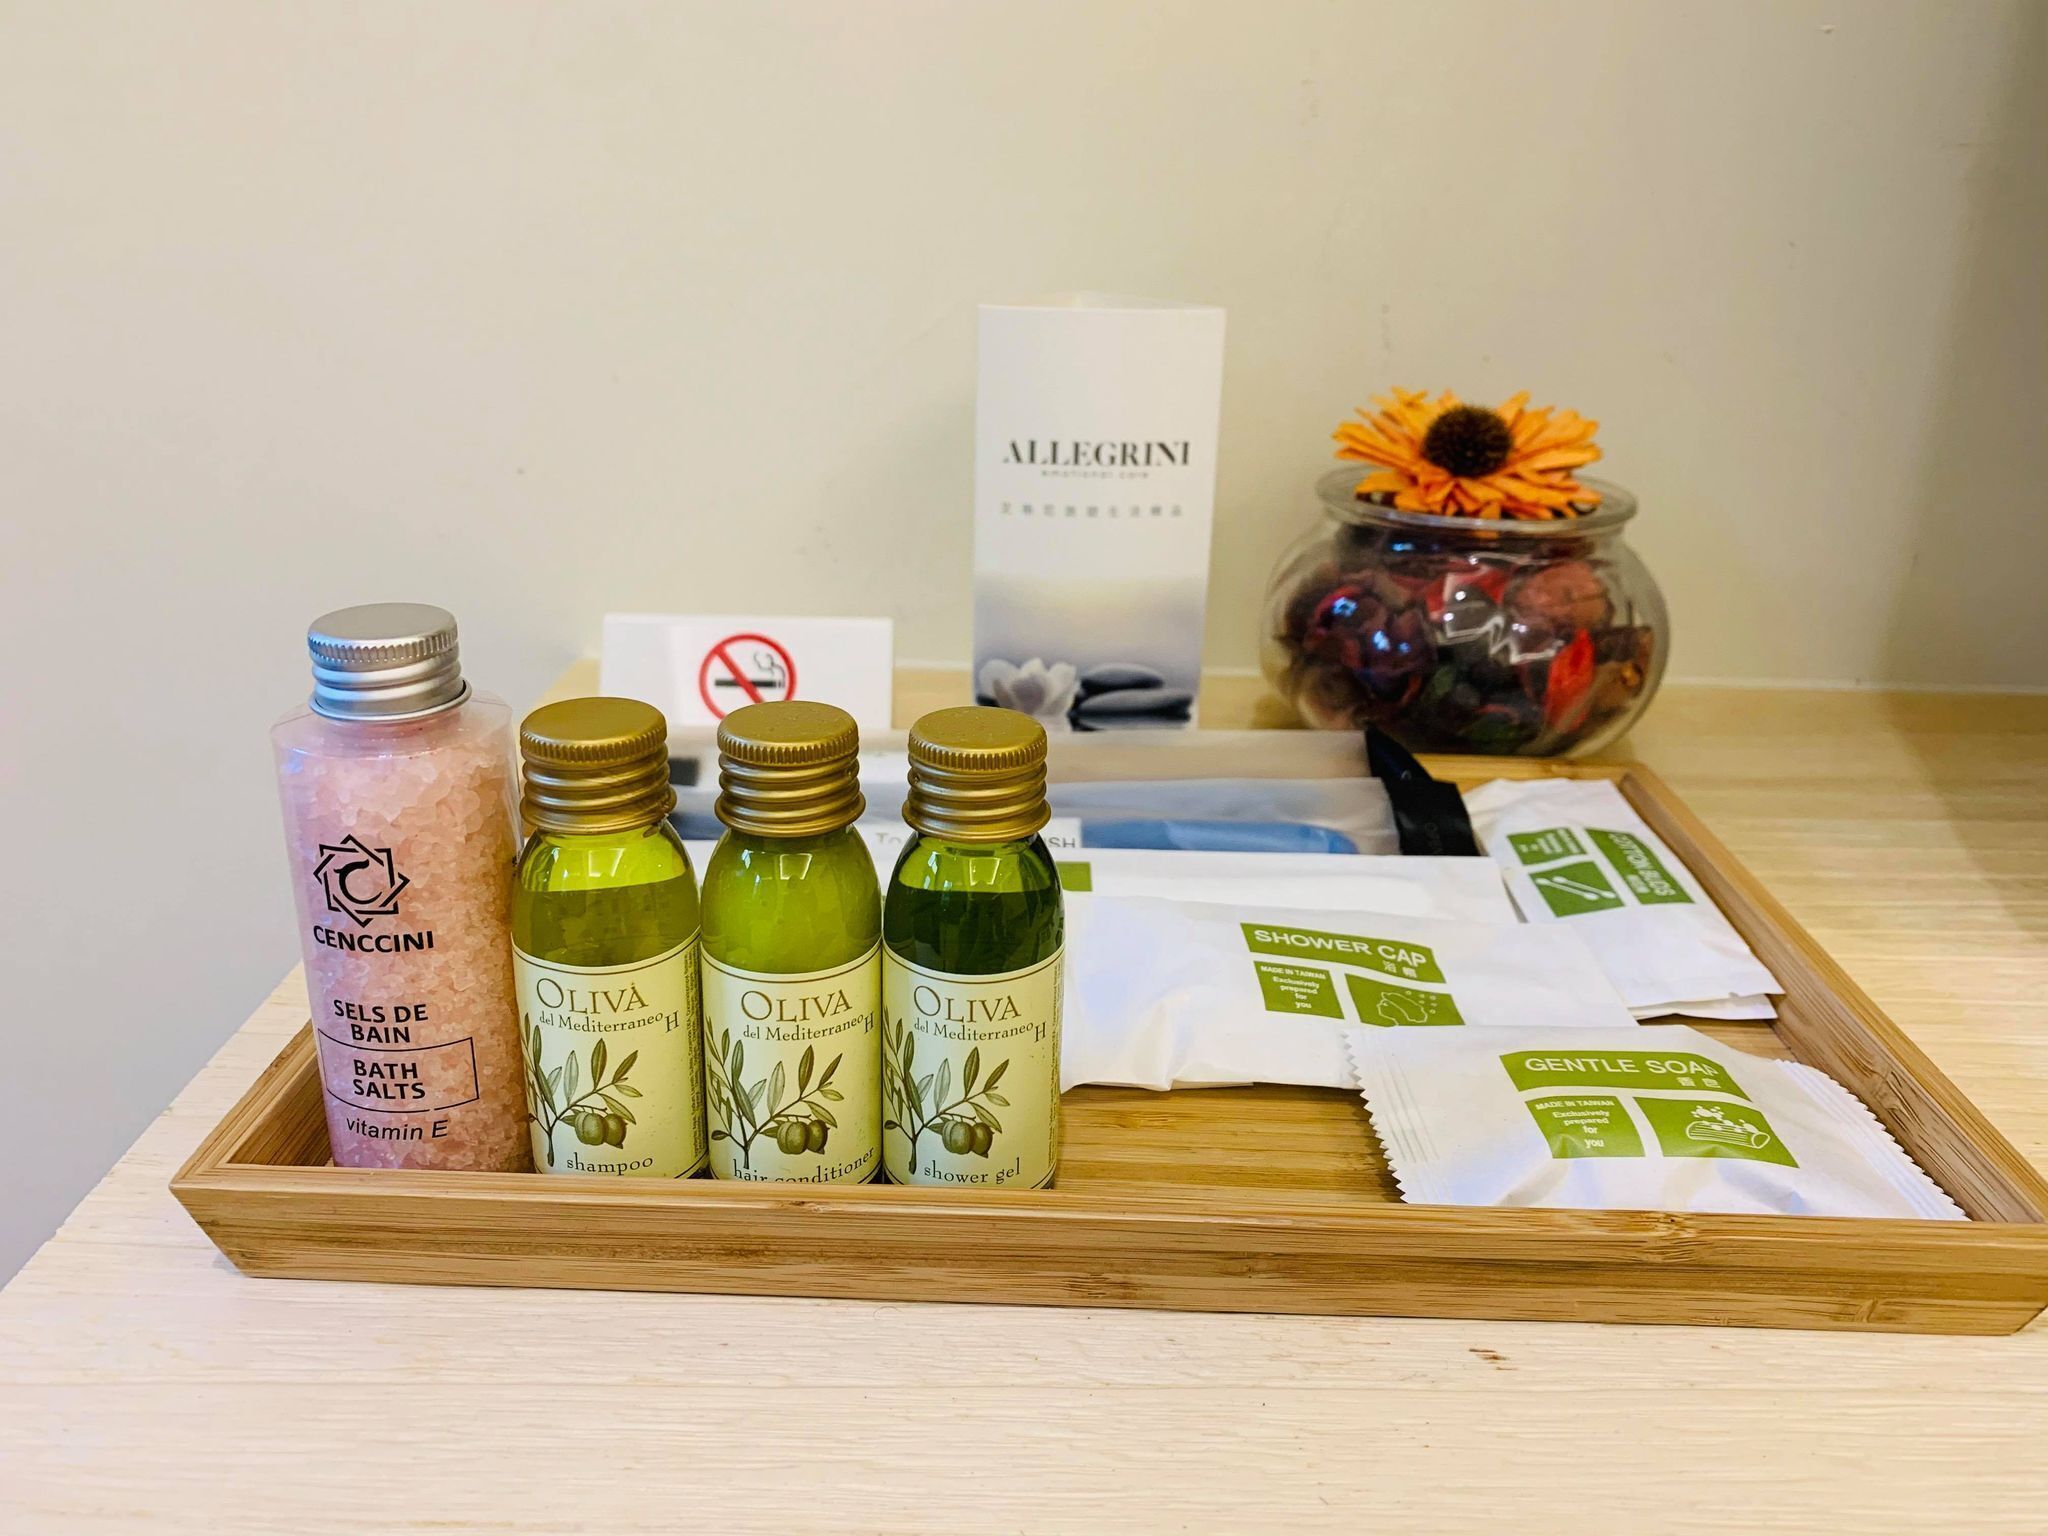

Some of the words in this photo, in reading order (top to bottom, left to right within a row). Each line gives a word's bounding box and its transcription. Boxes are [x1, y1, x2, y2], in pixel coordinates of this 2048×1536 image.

[1002, 440, 1191, 466] ALLEGRINI
[313, 925, 434, 953] CENCCINI
[1253, 928, 1373, 955] SHOWER
[1377, 945, 1427, 968] CAP
[333, 999, 386, 1023] SELS
[394, 1003, 429, 1023] DE
[539, 1010, 554, 1026] del
[558, 1012, 663, 1033] Mediterraneo
[351, 1023, 411, 1044] BAIN
[743, 1024, 760, 1039] del
[766, 1013, 864, 1042] Mediterraneo
[914, 1016, 929, 1032] del
[933, 1021, 1034, 1041] Mediterraneo
[353, 1058, 419, 1080] BATH
[1524, 1057, 1640, 1074] GENTLE
[352, 1078, 426, 1100] SALTS
[1552, 1110, 1610, 1118] Exclusively
[1564, 1117, 1610, 1126] prepared
[346, 1117, 424, 1141] vitamin
[431, 1119, 449, 1139] E
[1582, 1125, 1598, 1134] for
[1584, 1139, 1605, 1149] you
[566, 1152, 654, 1176] shampoo
[924, 1159, 989, 1184] shower
[996, 1157, 1021, 1185] gel
